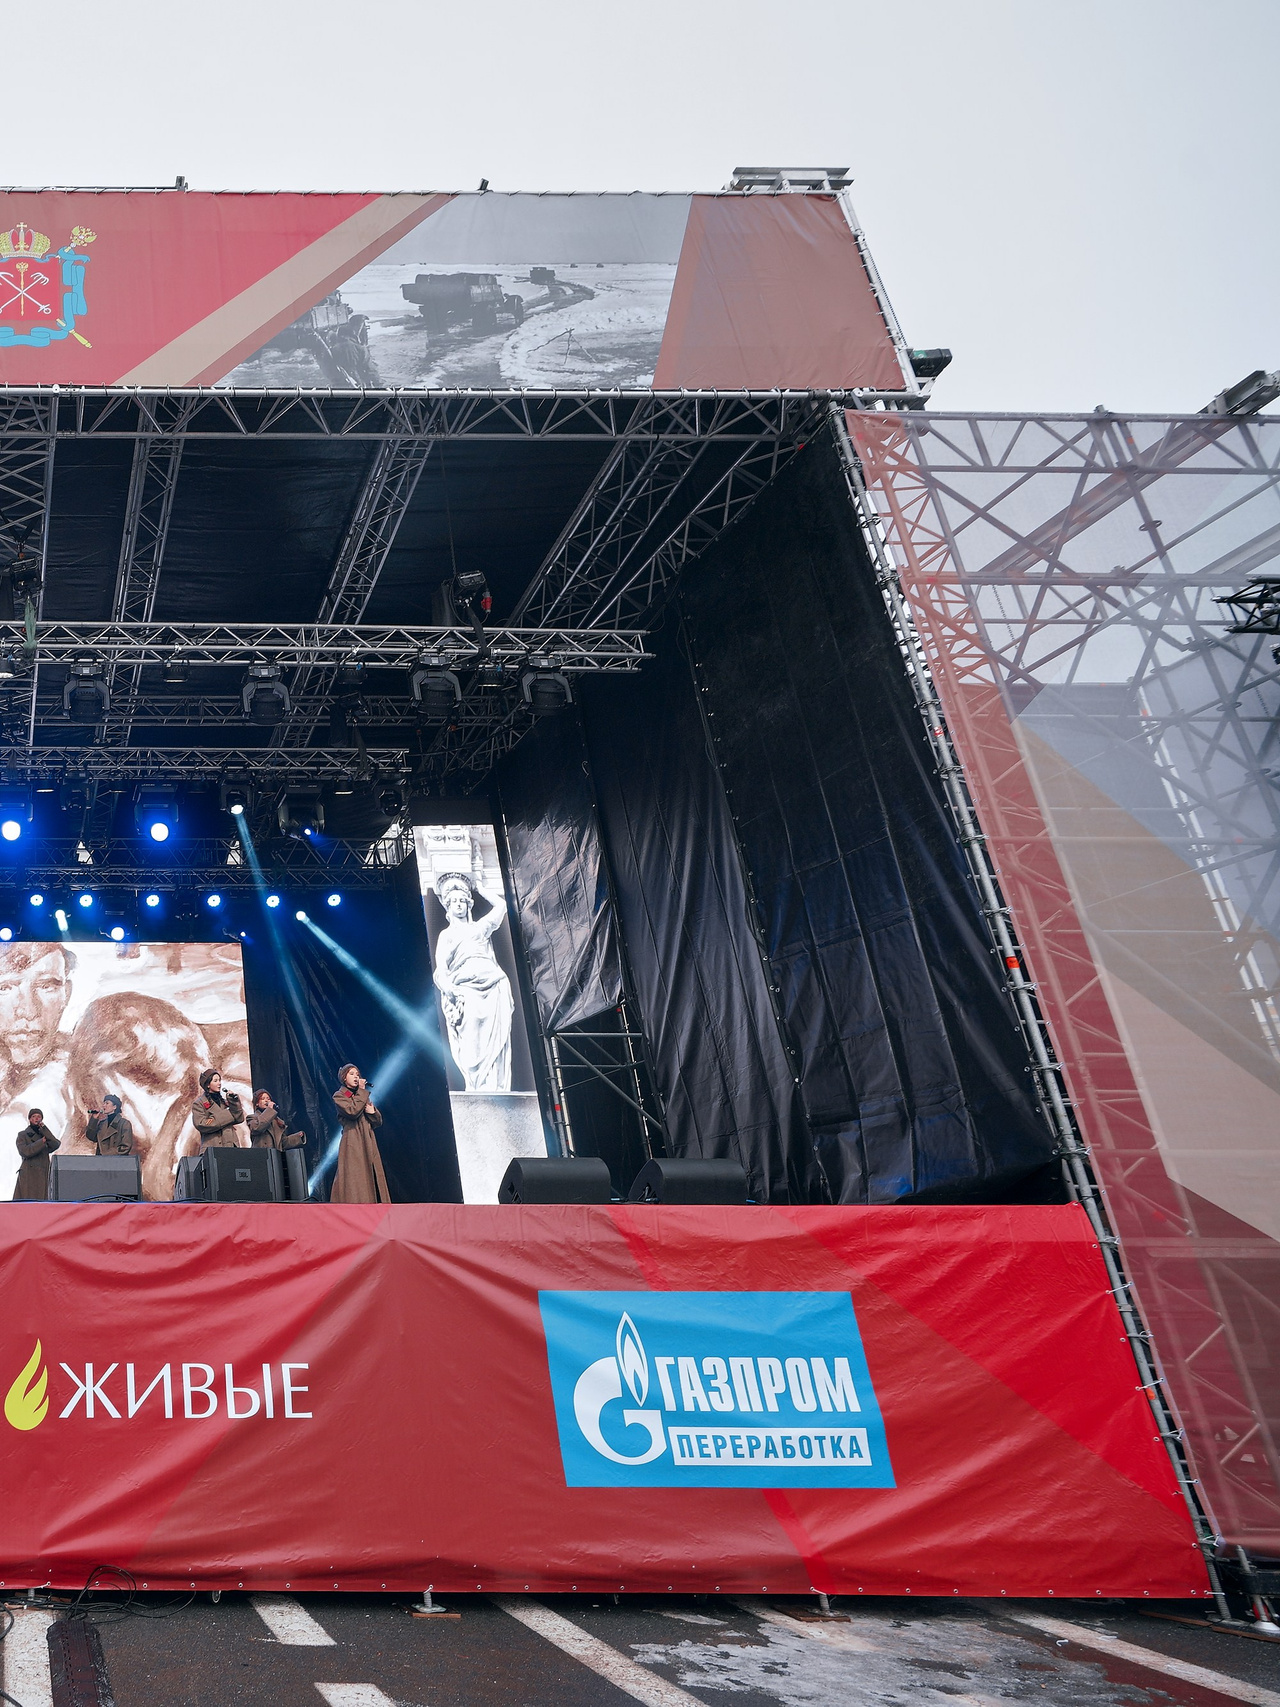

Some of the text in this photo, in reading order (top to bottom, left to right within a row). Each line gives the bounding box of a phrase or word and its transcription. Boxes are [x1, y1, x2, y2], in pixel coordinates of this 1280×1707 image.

[57, 1361, 314, 1419] ЖИВЫЕ
[654, 1356, 862, 1412] ГАЗПРОМ
[676, 1433, 864, 1460] ПЕРЕРАБОТКА
